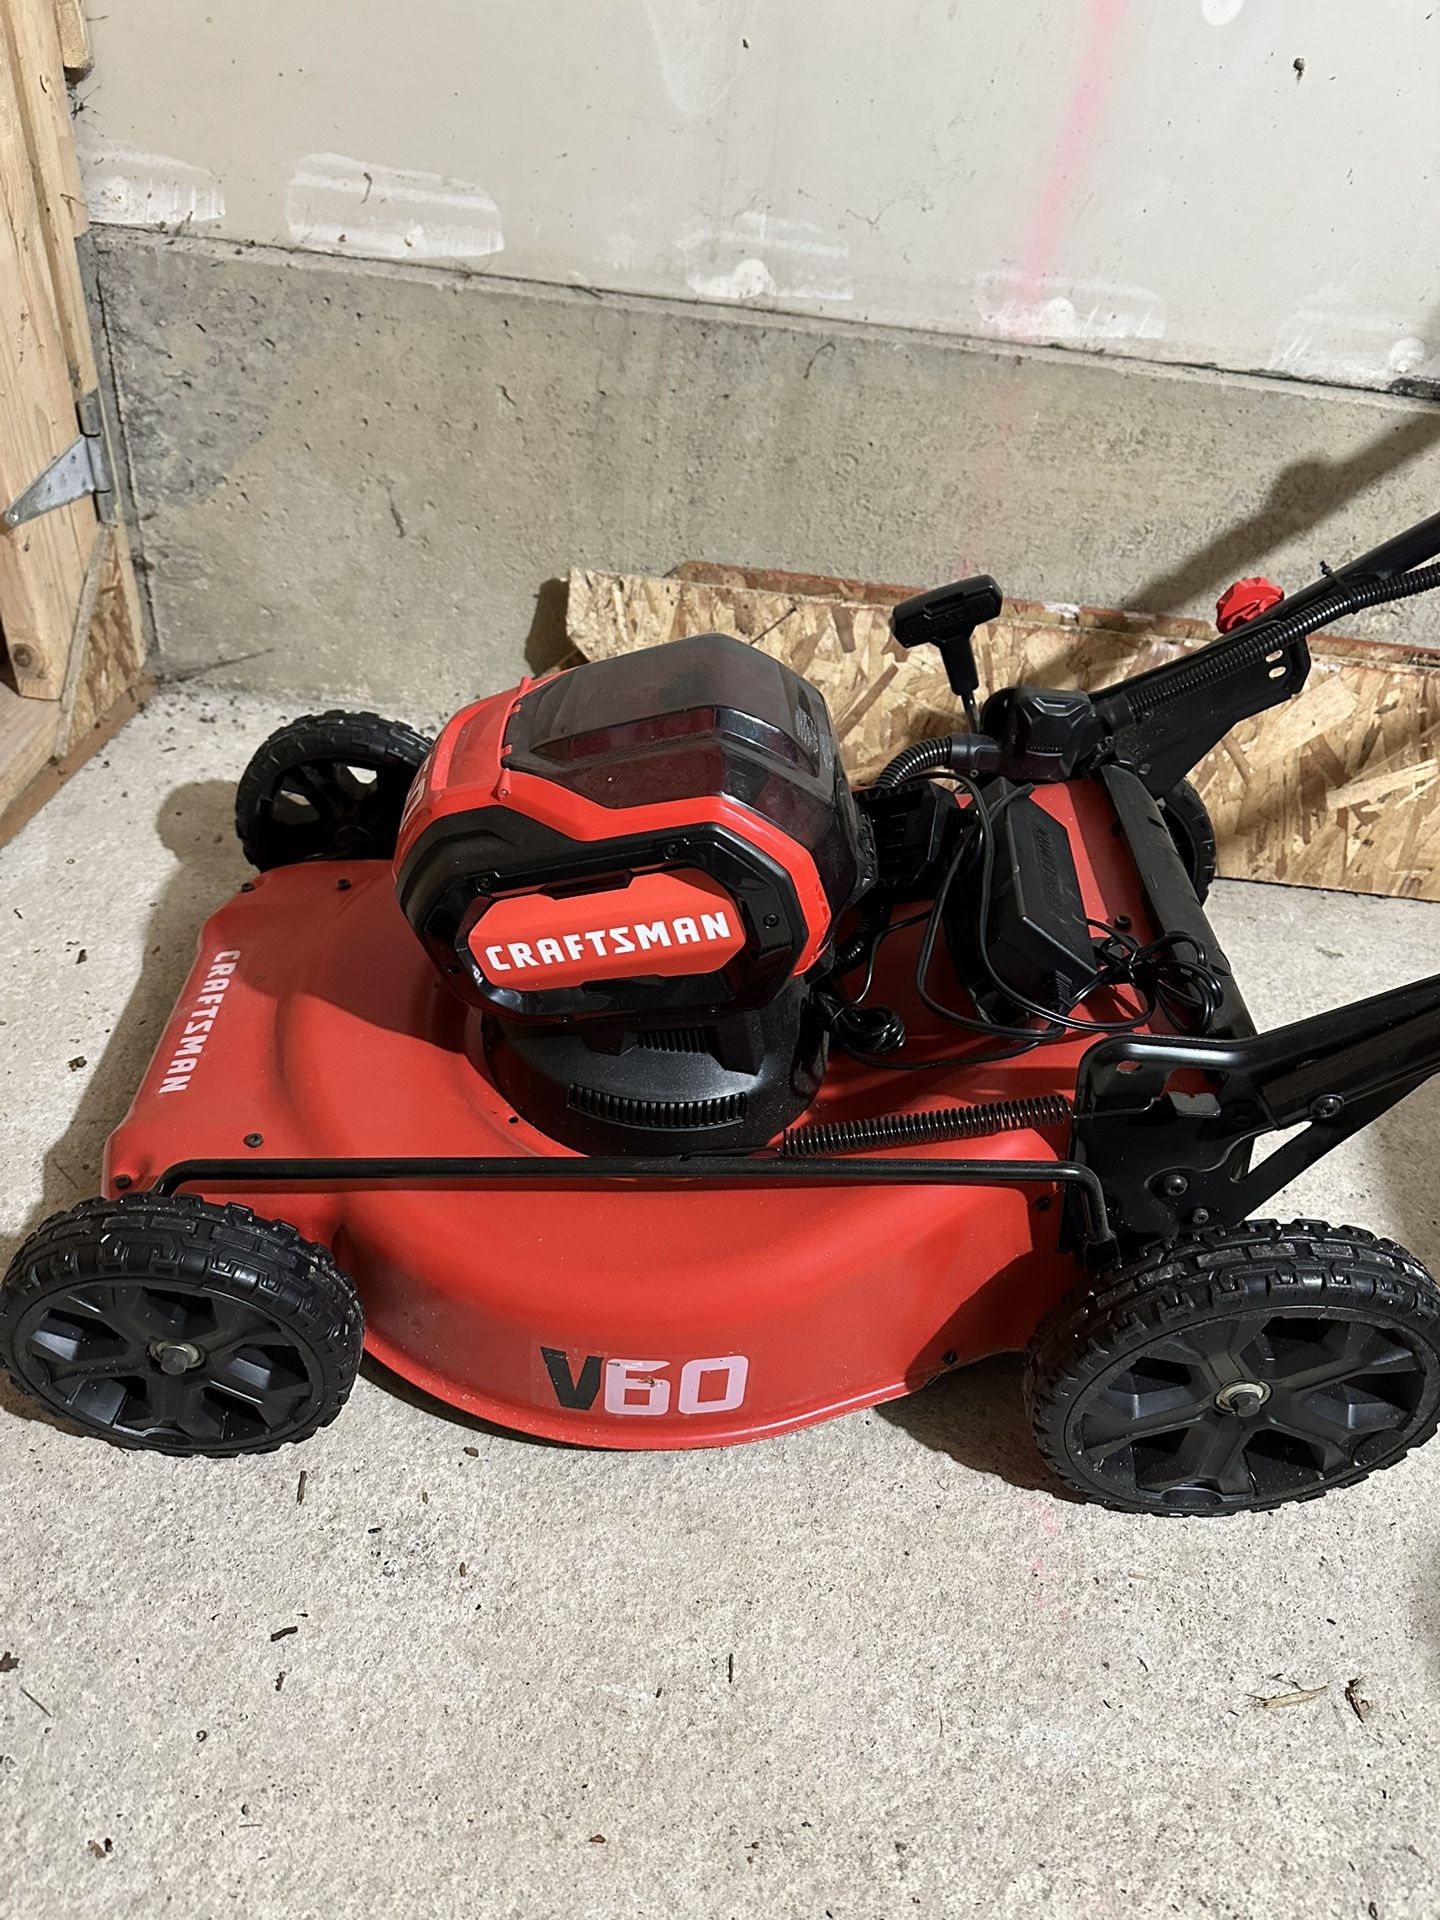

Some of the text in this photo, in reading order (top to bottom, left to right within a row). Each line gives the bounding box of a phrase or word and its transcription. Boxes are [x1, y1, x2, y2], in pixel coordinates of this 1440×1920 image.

[485, 911, 732, 971] CRAFTSMAN
[158, 949, 241, 1094] CRAFTSMAN
[539, 1346, 749, 1415] V60
